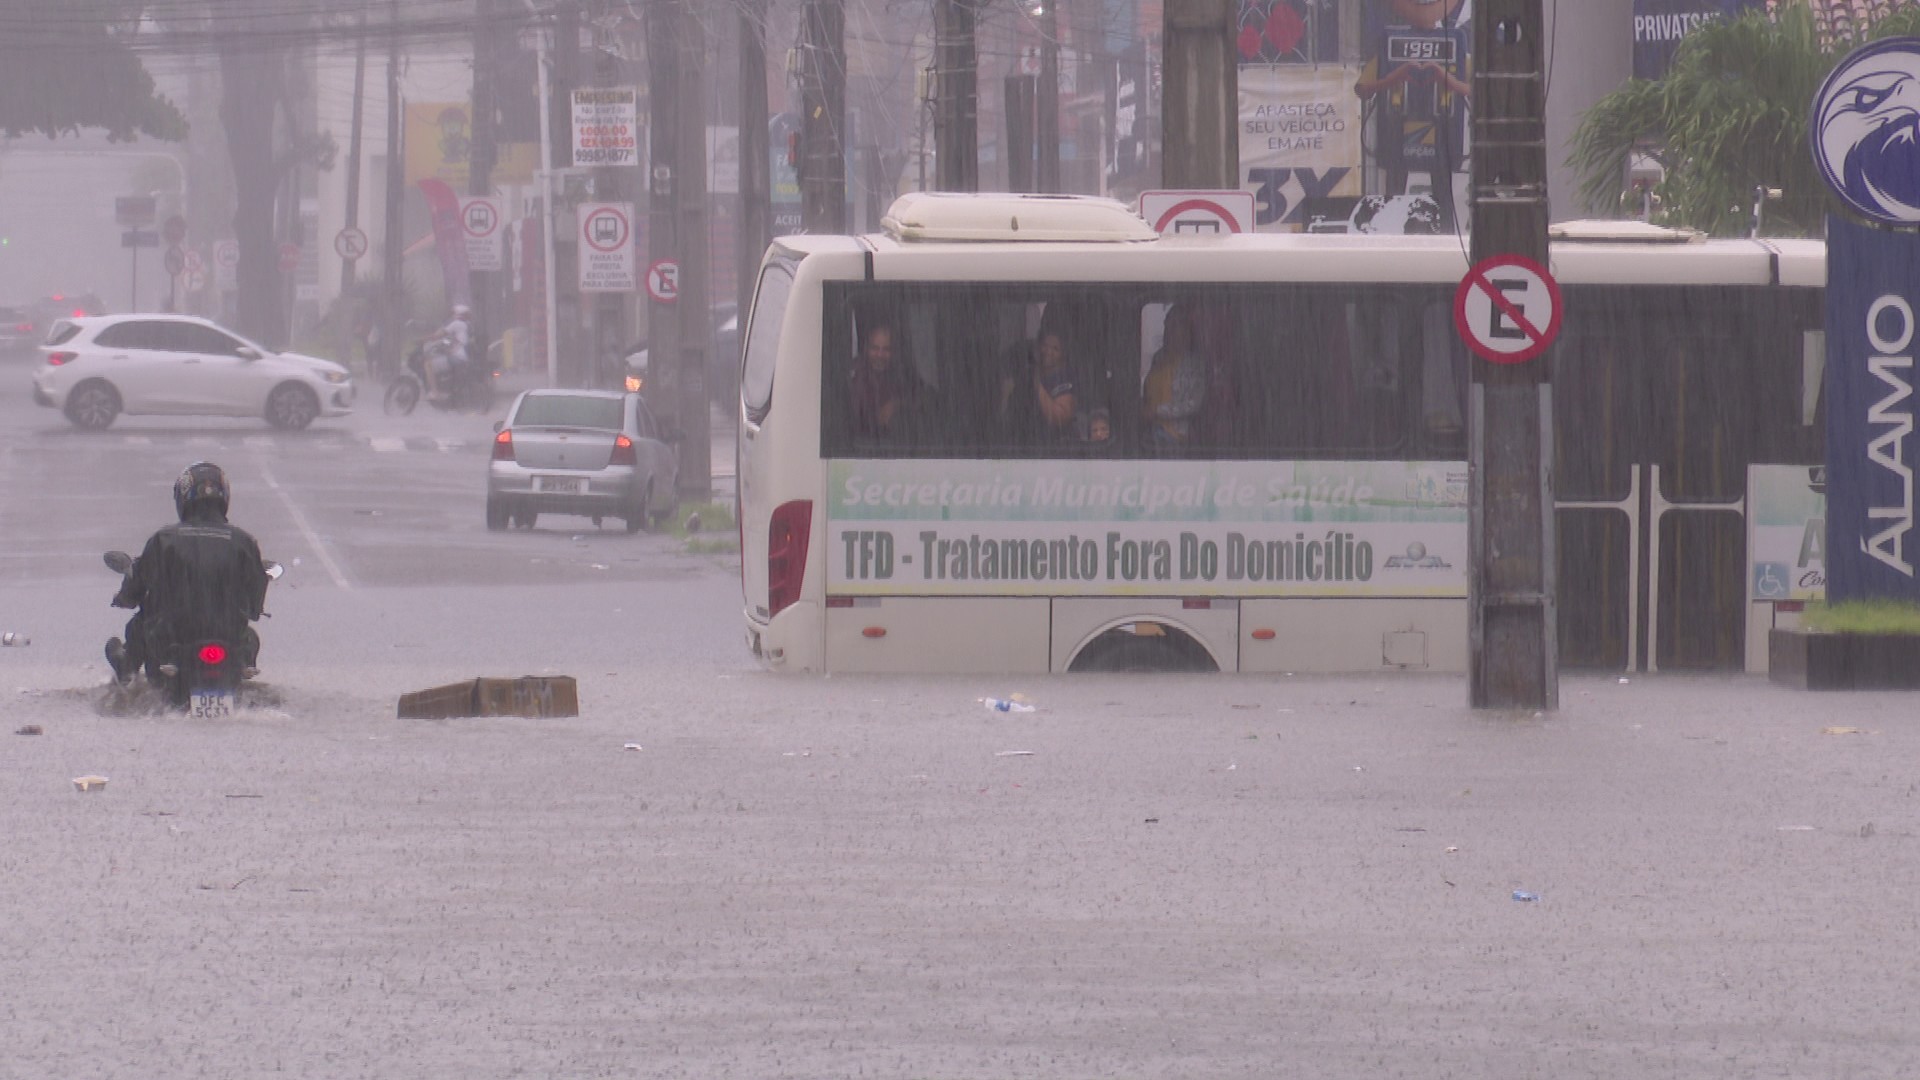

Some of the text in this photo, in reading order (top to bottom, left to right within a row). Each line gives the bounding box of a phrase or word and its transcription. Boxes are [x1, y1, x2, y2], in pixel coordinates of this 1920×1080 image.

[1403, 42, 1440, 58] 1991
[1246, 120, 1276, 134] SEU
[1267, 133, 1324, 150] EM ATÉ
[1860, 295, 1914, 578] ÁLAMO
[843, 473, 1374, 516] Secretaria Municipal de Saúde
[841, 531, 894, 580] TFD
[919, 530, 1098, 581] Tratamento
[1106, 531, 1172, 581] Fora
[1180, 531, 1218, 582] Do
[1226, 530, 1373, 582] Domicílio
